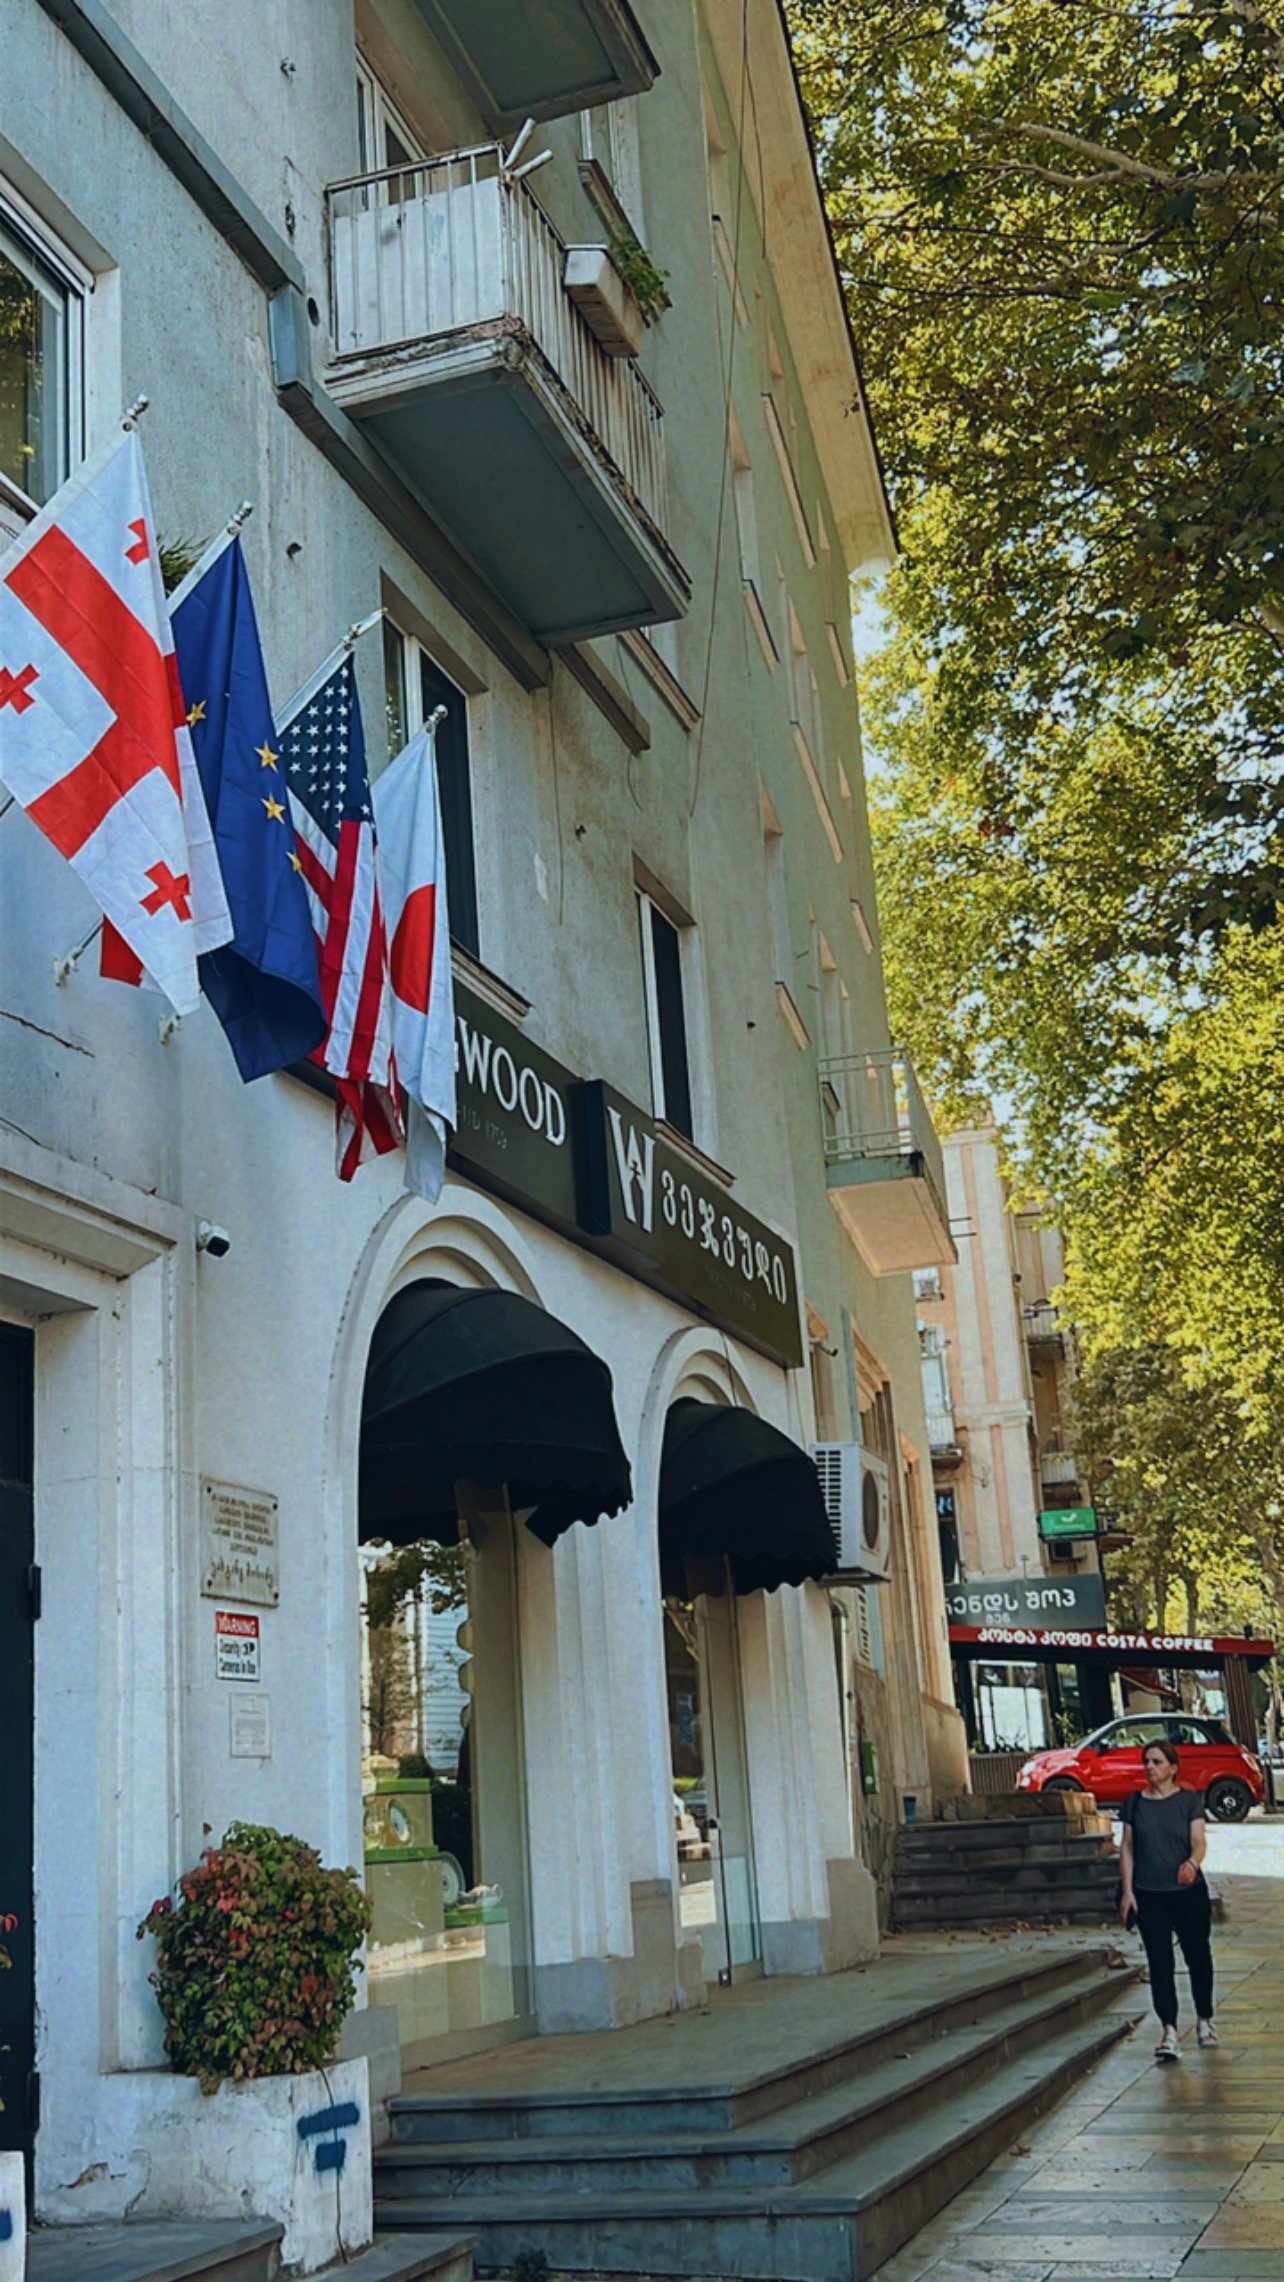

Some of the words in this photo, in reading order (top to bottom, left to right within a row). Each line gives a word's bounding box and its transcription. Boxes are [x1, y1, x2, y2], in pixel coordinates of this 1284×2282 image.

[455, 1016, 565, 1146] WOOD
[661, 1169, 787, 1304] ვეჯვუდი
[1025, 1588, 1076, 1610] შოპ
[218, 1615, 256, 1637] WARNING
[977, 1627, 1037, 1645] კოსტა
[1040, 1630, 1093, 1647] კოფი
[1096, 1634, 1148, 1650] COSTA
[1151, 1637, 1214, 1652] COFFEE
